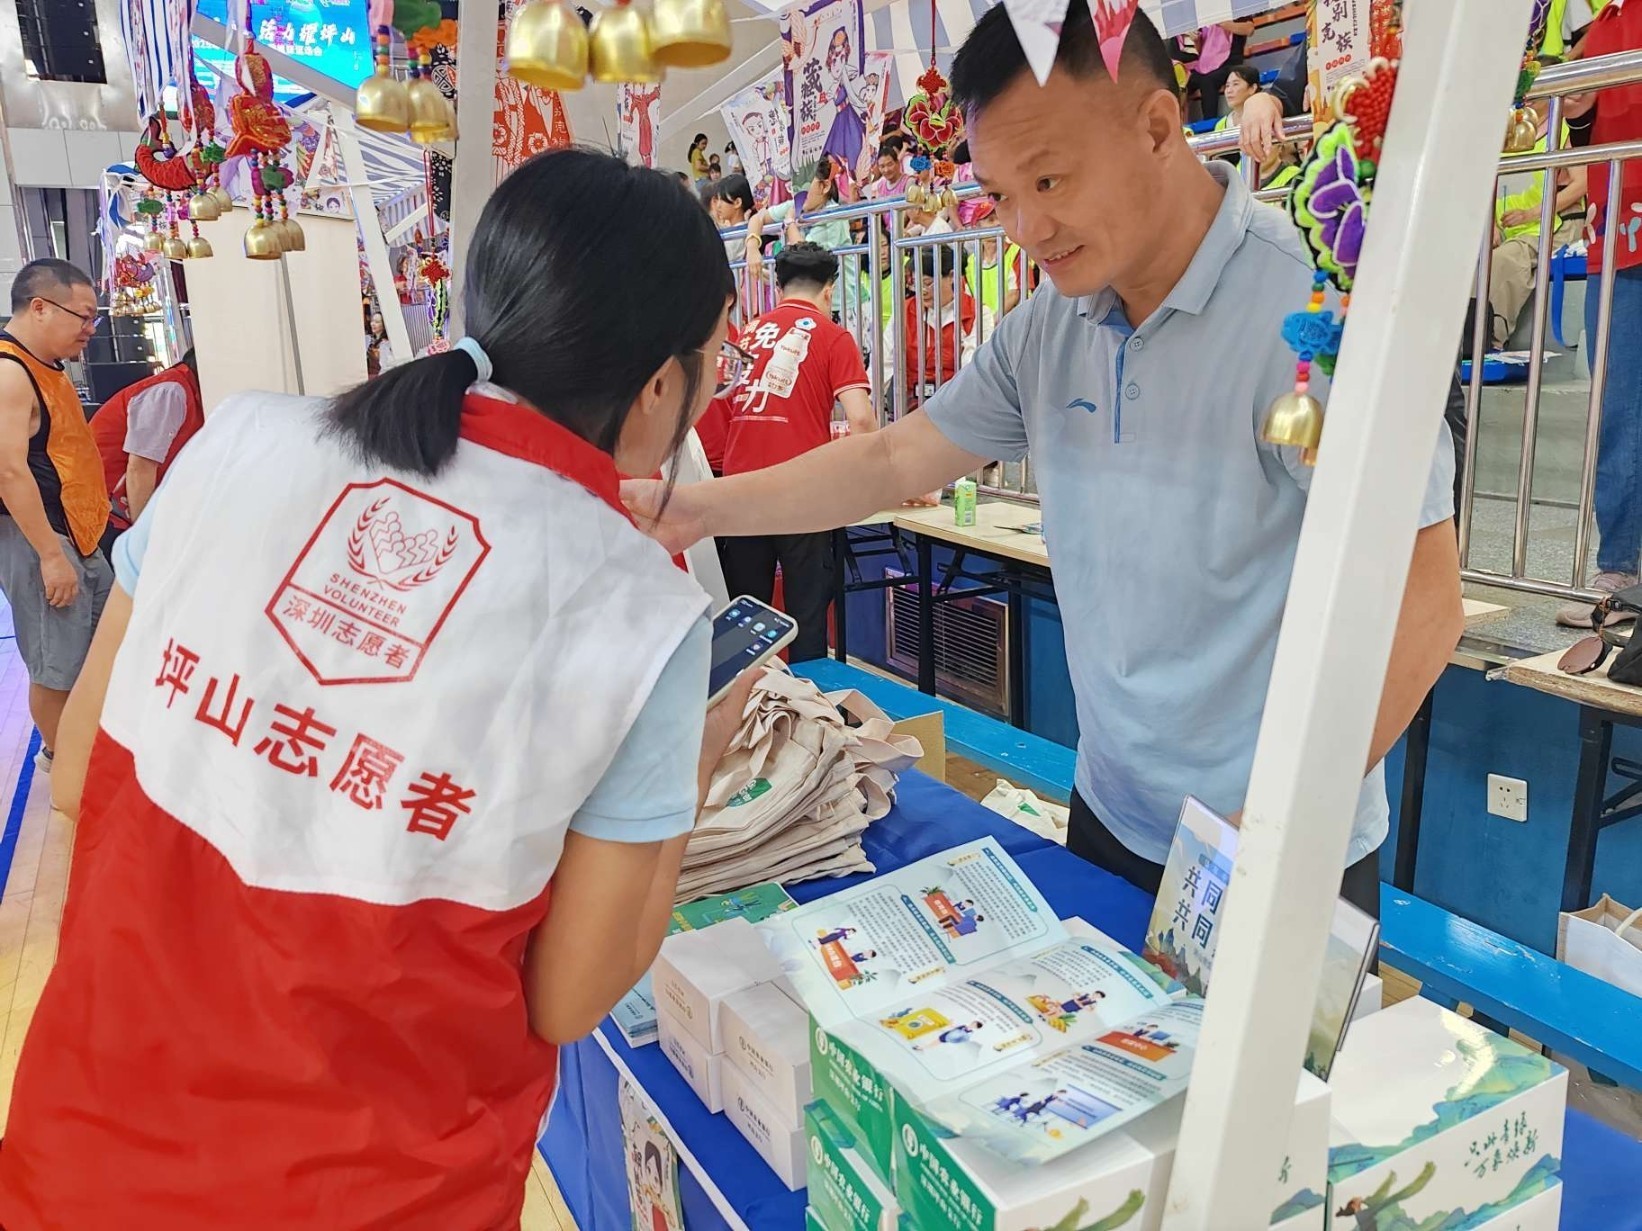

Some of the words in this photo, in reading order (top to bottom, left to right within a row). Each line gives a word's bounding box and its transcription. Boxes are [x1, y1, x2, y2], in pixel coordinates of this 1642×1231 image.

[259, 18, 355, 47] 活力耀坪山
[324, 585, 400, 628] VOLUNTEER
[329, 572, 407, 615] SHENZHEN
[282, 595, 410, 669] 深圳志愿者
[154, 637, 478, 843] 坪山志愿者
